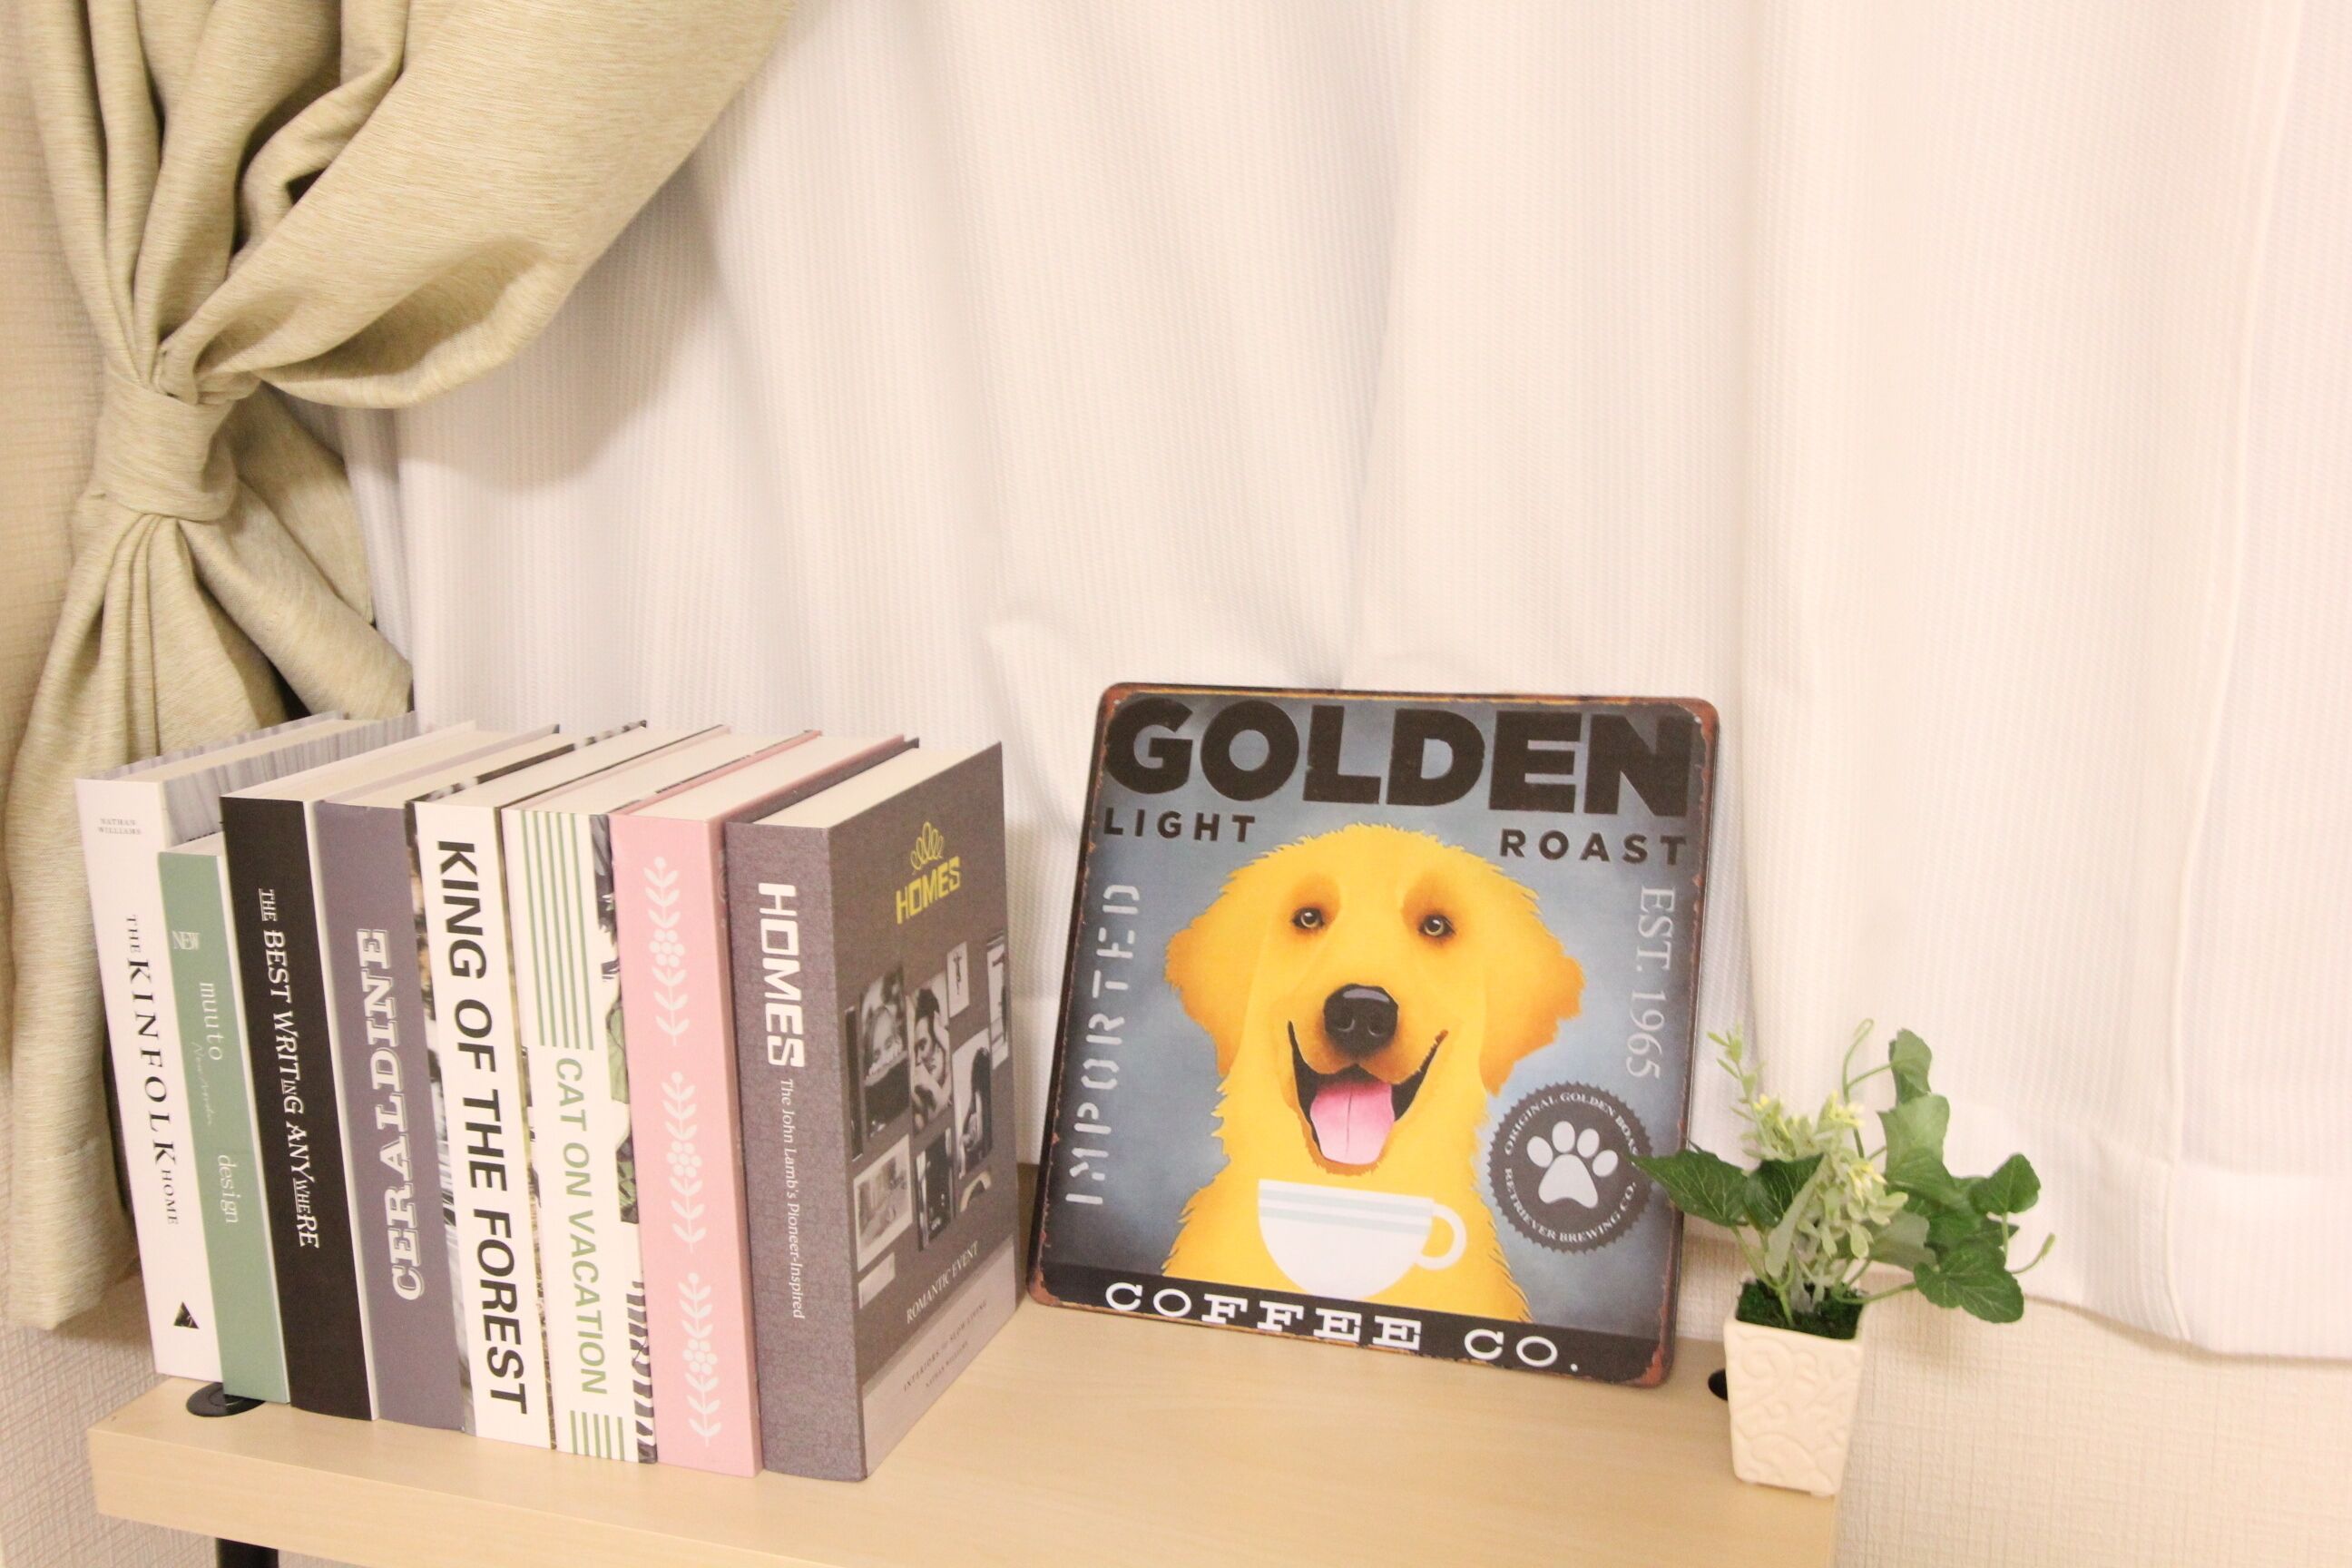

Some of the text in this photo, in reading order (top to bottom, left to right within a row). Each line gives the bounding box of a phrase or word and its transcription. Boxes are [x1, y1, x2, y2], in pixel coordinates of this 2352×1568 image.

[1102, 700, 1691, 817] GOLDEN
[896, 856, 962, 925] HOMES
[1103, 807, 1686, 866] LIGHT ROAST
[200, 982, 224, 1061] muuto
[758, 883, 805, 1067] HOMES
[1626, 885, 1675, 1080] EST. 1965
[125, 915, 180, 1225] THE KINFOLK HOME
[258, 887, 319, 1249] THE BEST WRITING ANYWHERE
[1065, 884, 1141, 1206] IMPORTED
[437, 840, 527, 1416] KING OF THE FOREST
[1504, 1095, 1558, 1155] ORIGINAL
[1560, 1092, 1616, 1116] GOLDEN
[218, 1154, 239, 1224] design
[556, 1057, 607, 1395] CAT ON VACATION
[780, 1078, 805, 1319] The John Lamb's Pioneer-Inspired
[1504, 1168, 1556, 1240] RETRIEVER
[1559, 1211, 1621, 1243] BREWING
[906, 1269, 951, 1325] ROMANTIC
[952, 1240, 979, 1278] EVENT
[1103, 1280, 1579, 1372] COFFEE CO.
